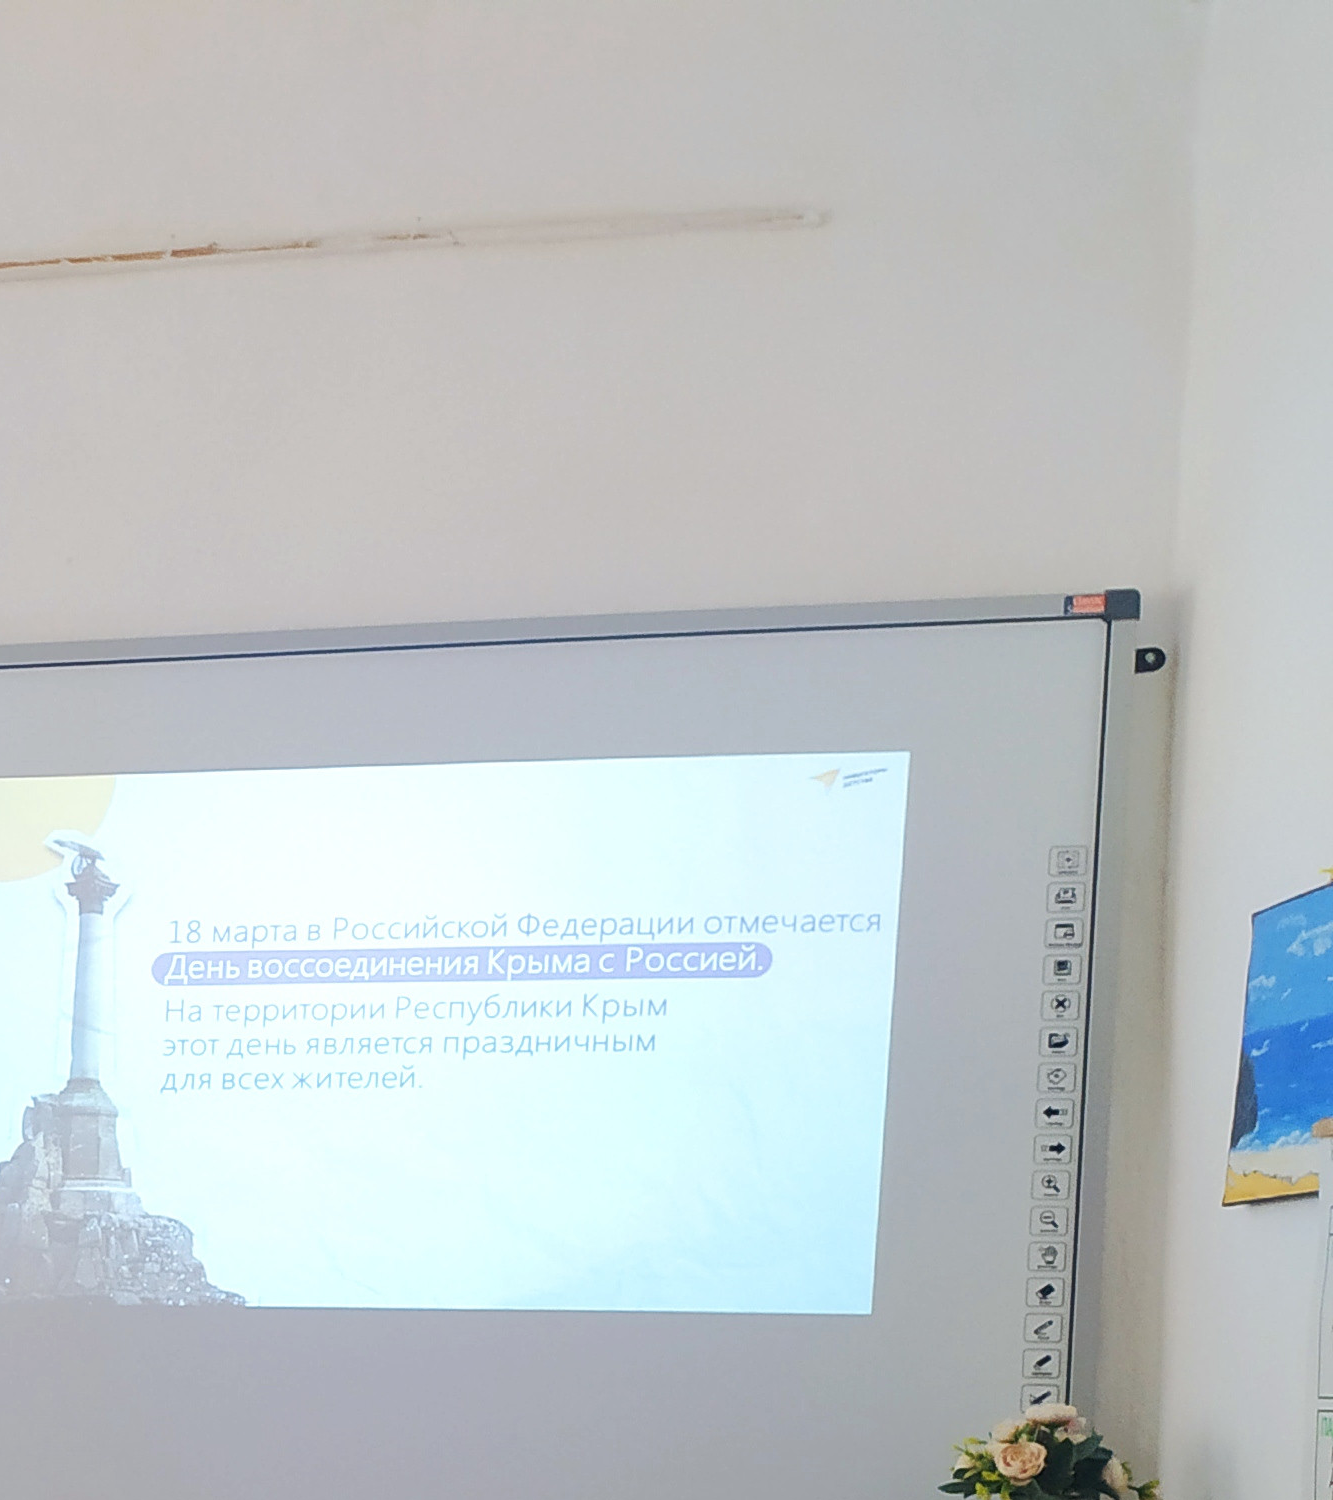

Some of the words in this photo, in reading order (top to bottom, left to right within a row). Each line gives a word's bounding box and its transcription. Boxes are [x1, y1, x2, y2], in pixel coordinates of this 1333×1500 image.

[169, 919, 202, 944] 18
[212, 924, 297, 950] марта
[307, 923, 321, 942] в
[333, 912, 508, 941] Российской
[517, 912, 695, 943] Федерации
[703, 913, 882, 935] отмечается
[163, 954, 239, 985] День
[248, 952, 479, 983] воссоединения
[485, 945, 589, 983] Крыма
[599, 956, 614, 974] с
[625, 943, 763, 974] Россией.
[165, 999, 202, 1023] На
[212, 1002, 385, 1028] территории
[395, 993, 573, 1027] Республики
[582, 993, 668, 1024] Крым
[162, 1038, 220, 1057] этот
[225, 1038, 297, 1060] день
[305, 1036, 433, 1055] является
[443, 1033, 656, 1061] праздничным
[159, 1072, 212, 1094] для
[221, 1072, 284, 1091] всех
[291, 1064, 423, 1090] жителей.
